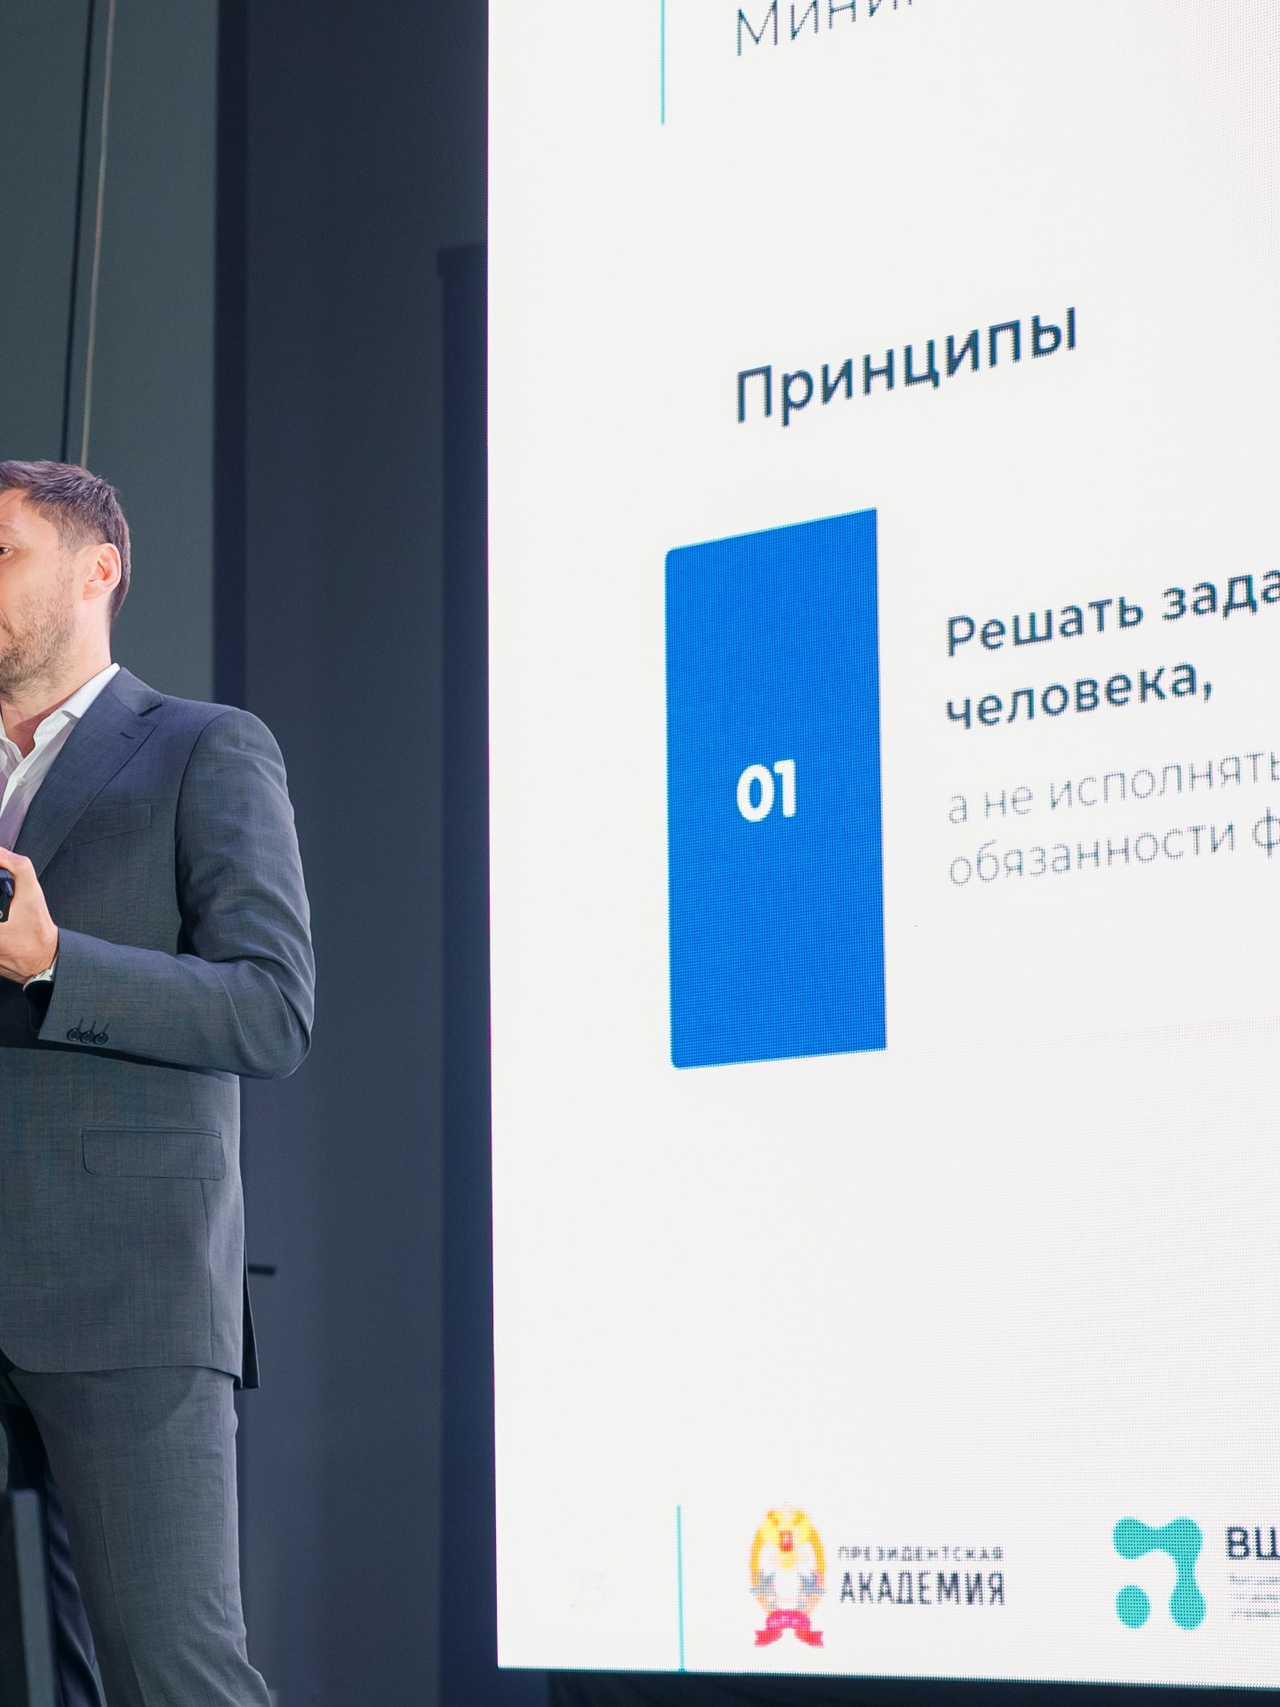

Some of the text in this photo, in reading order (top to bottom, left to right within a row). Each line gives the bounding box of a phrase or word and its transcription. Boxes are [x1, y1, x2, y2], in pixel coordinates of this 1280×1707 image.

[736, 0, 913, 56] Мин
[737, 306, 1076, 428] Принципы
[946, 569, 1280, 657] Решать зада
[946, 662, 1213, 729] человека,
[736, 759, 797, 822] 01
[948, 794, 968, 824] а
[984, 785, 1034, 820] не
[948, 823, 1236, 886] обязанности
[836, 1545, 1004, 1562] ПРЕЗИДЕНТСКАЯ
[839, 1571, 1005, 1606] АКАДЕМИЯ
